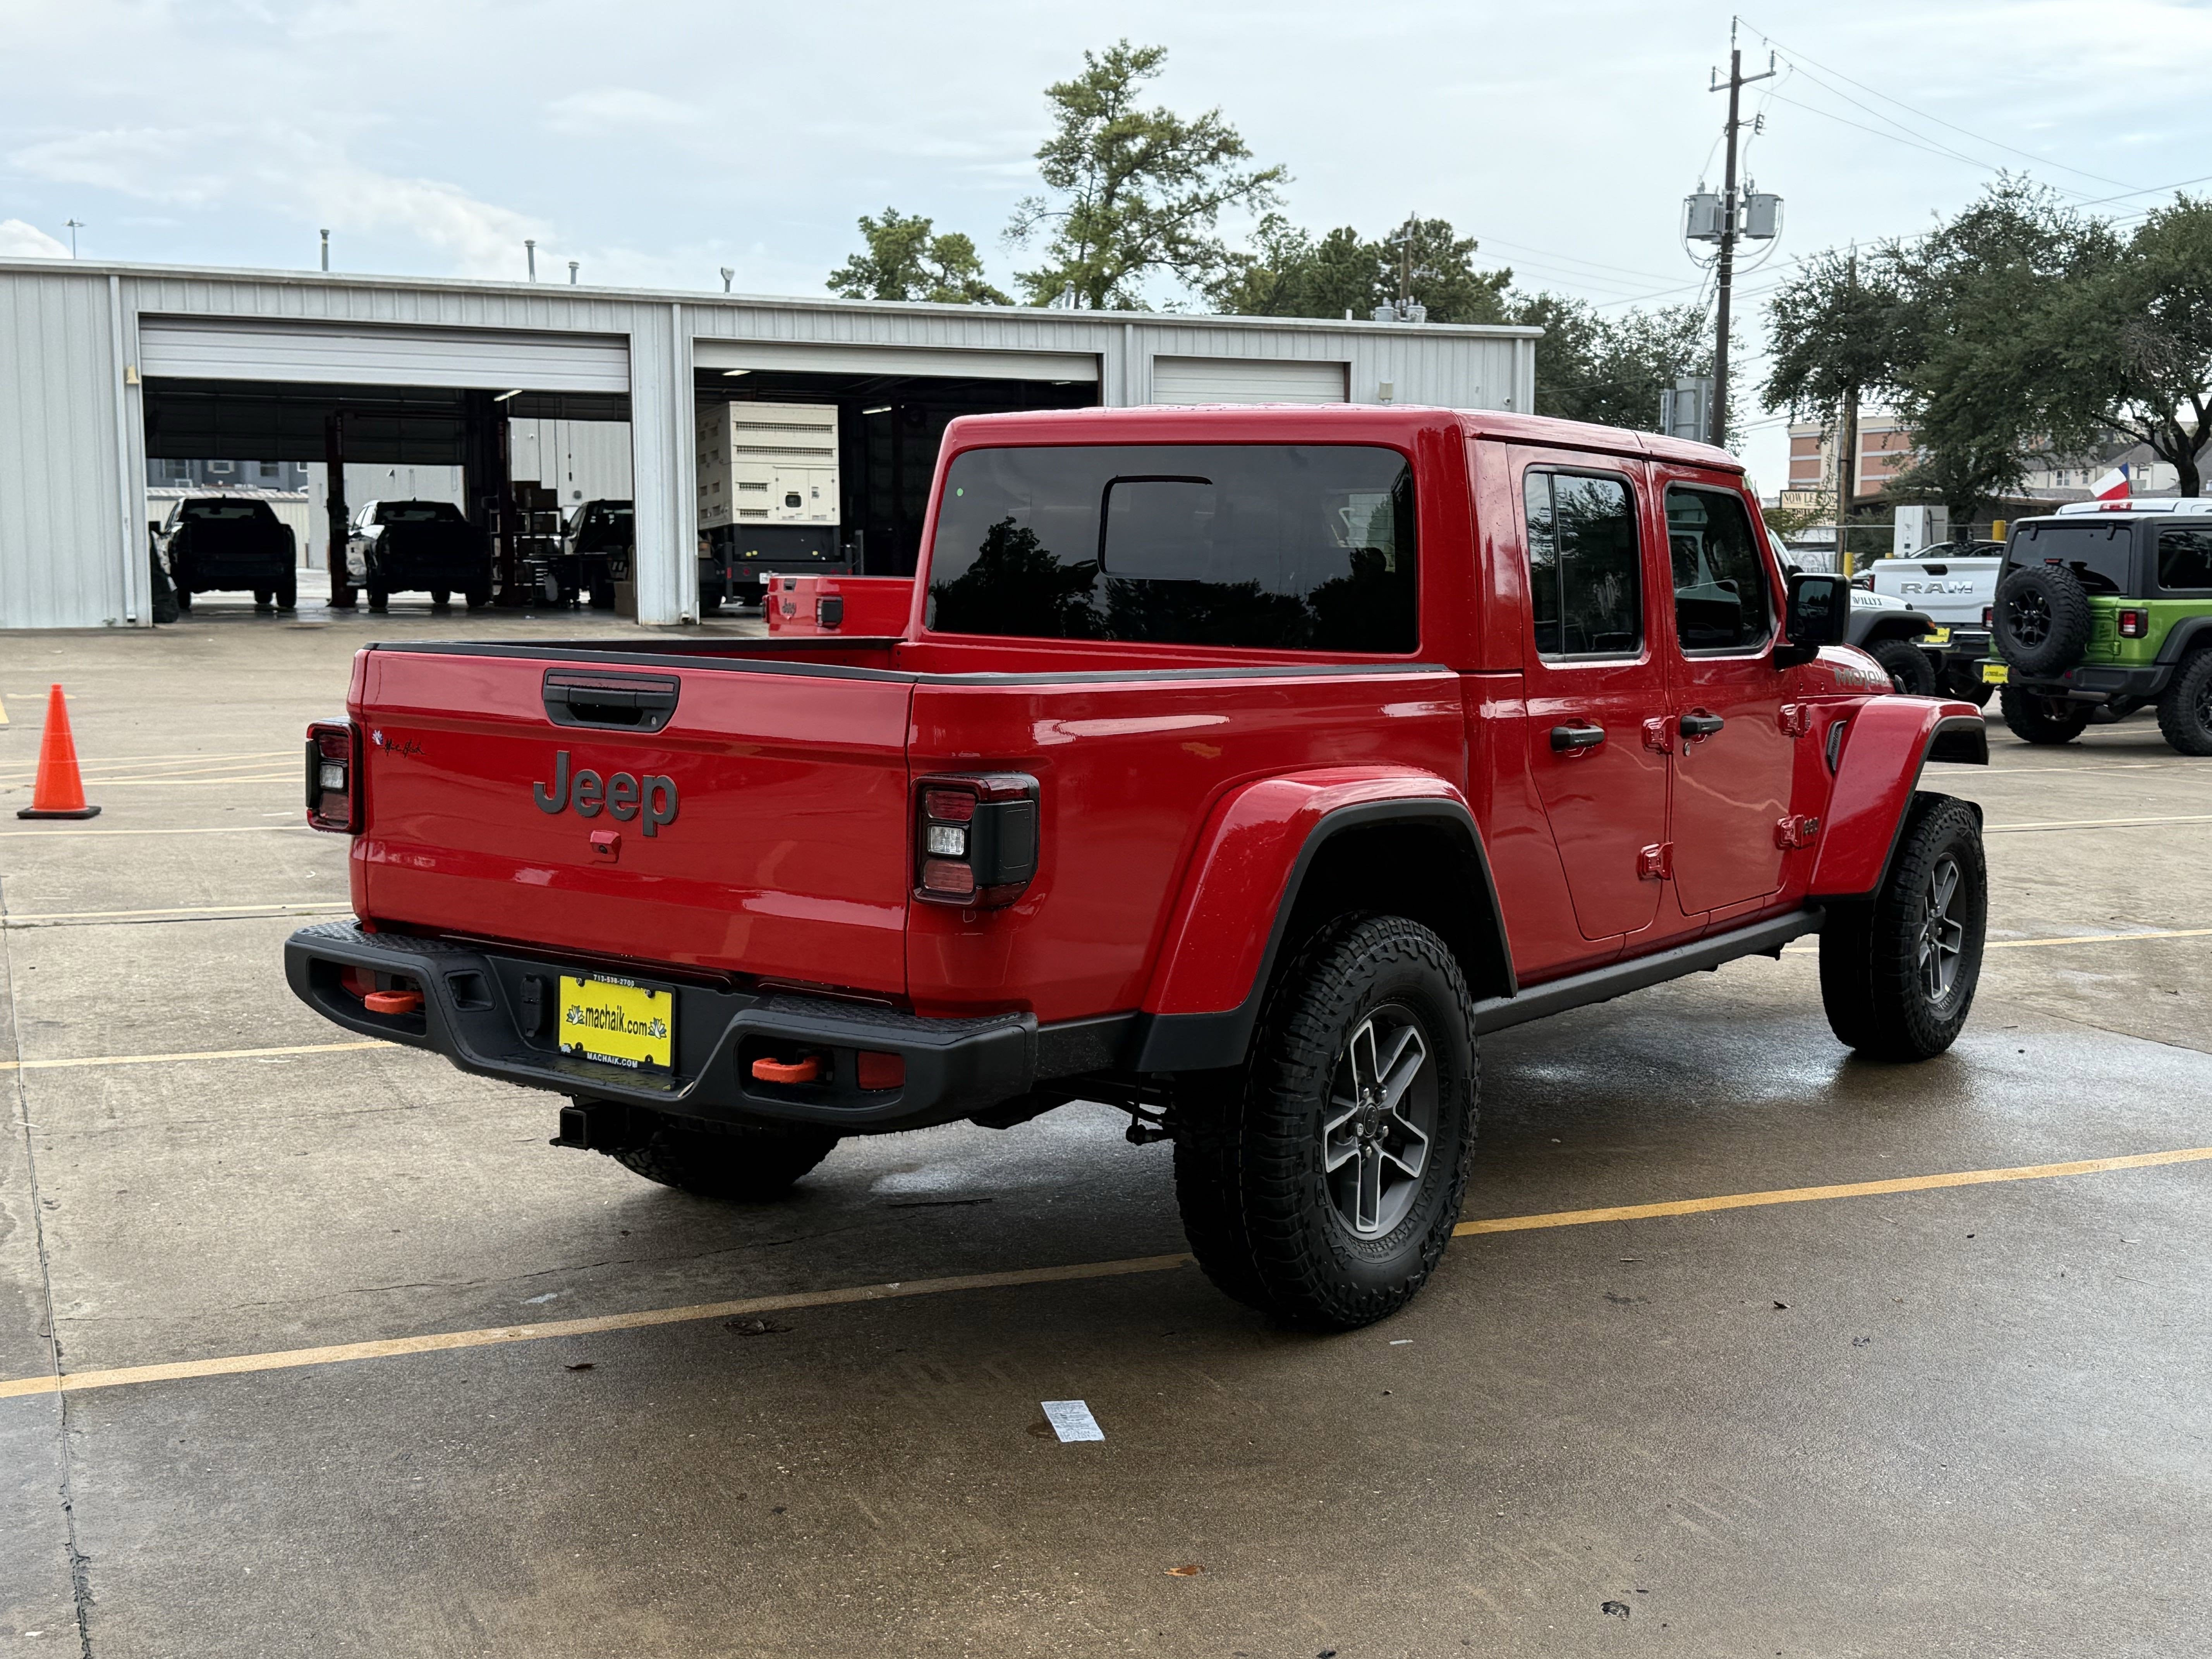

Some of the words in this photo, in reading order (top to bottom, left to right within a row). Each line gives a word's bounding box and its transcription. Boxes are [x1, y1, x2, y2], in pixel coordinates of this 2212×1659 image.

[1784, 493, 1801, 503] NOW
[1900, 581, 1973, 594] RAM
[1852, 596, 1882, 606] WILLYS
[533, 750, 679, 838] Jeep
[585, 1004, 647, 1036] machaik.com
[587, 1052, 638, 1068] MACHAIK.COM
